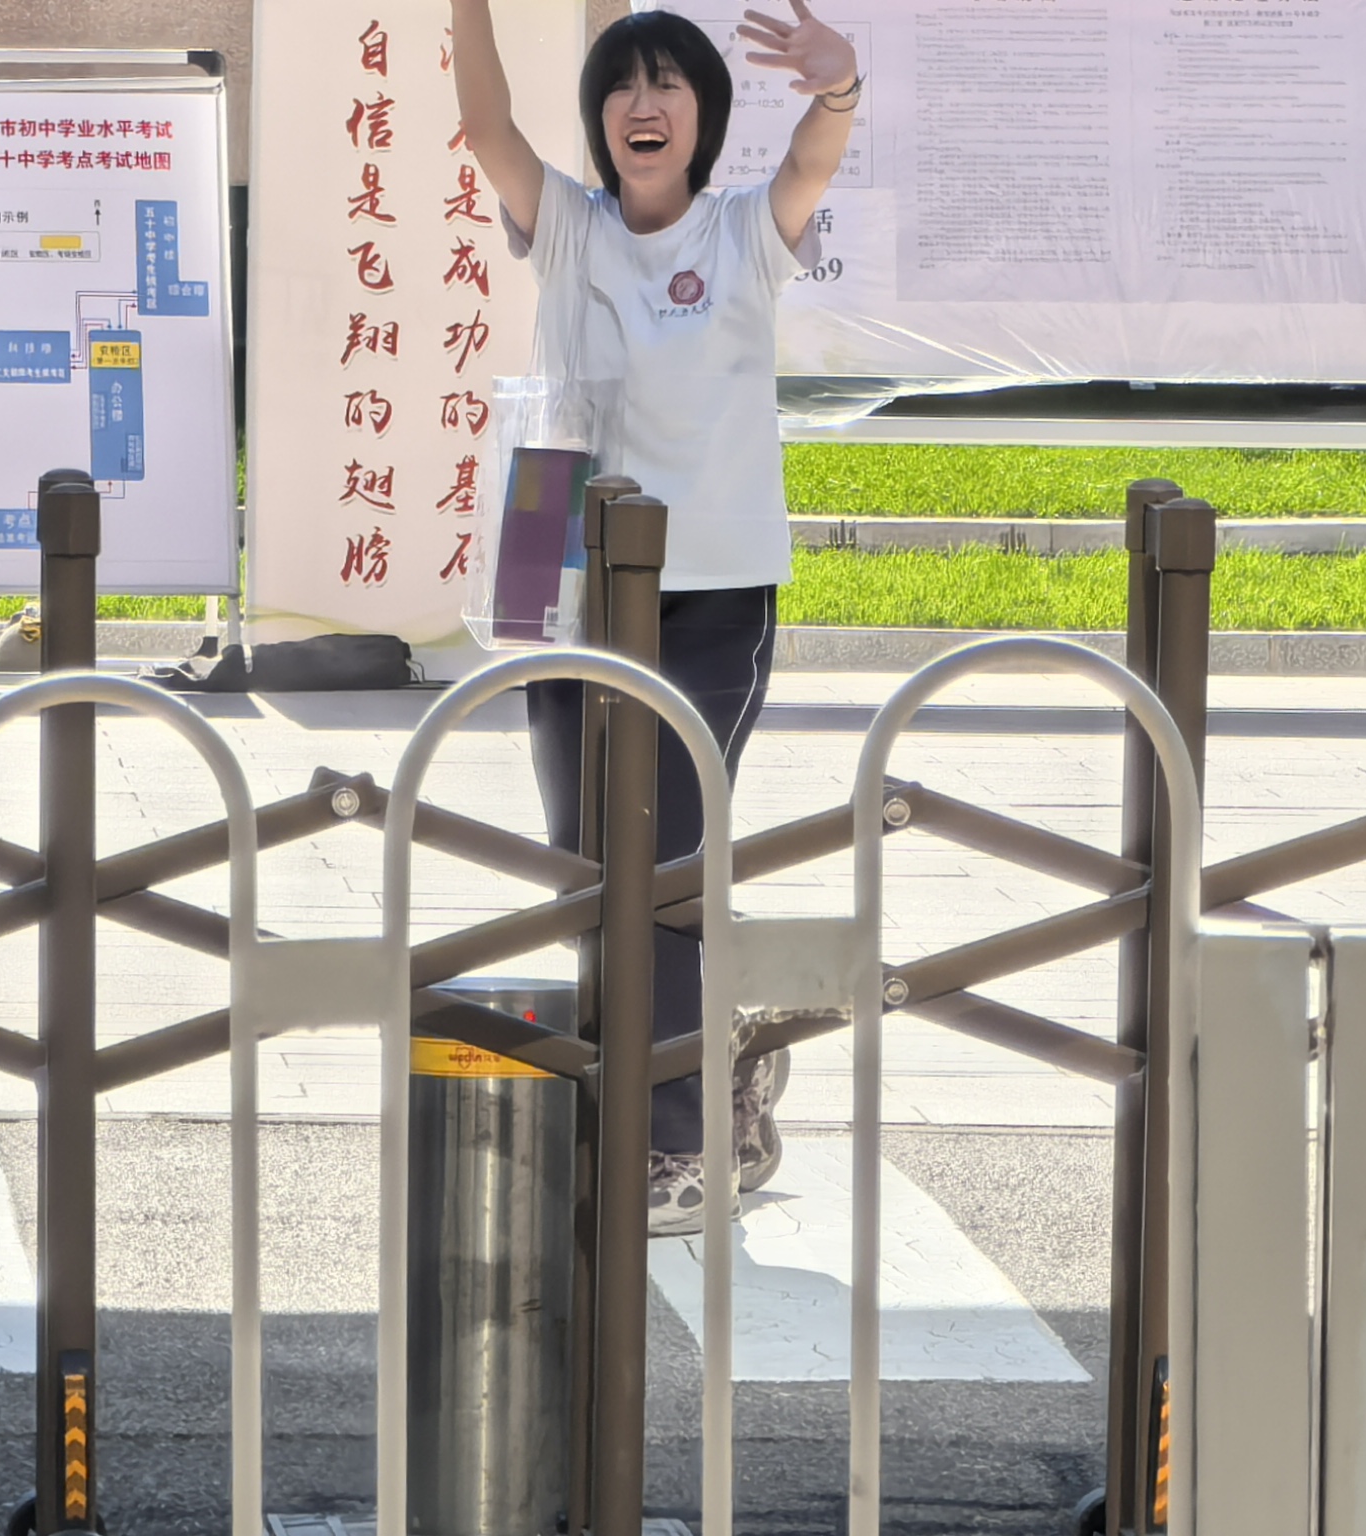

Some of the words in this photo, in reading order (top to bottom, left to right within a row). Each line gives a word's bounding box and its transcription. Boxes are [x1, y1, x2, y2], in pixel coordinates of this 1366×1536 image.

[339, 20, 399, 583] 自信是飞翔的翅膀
[436, 27, 492, 579] 是成功的基石
